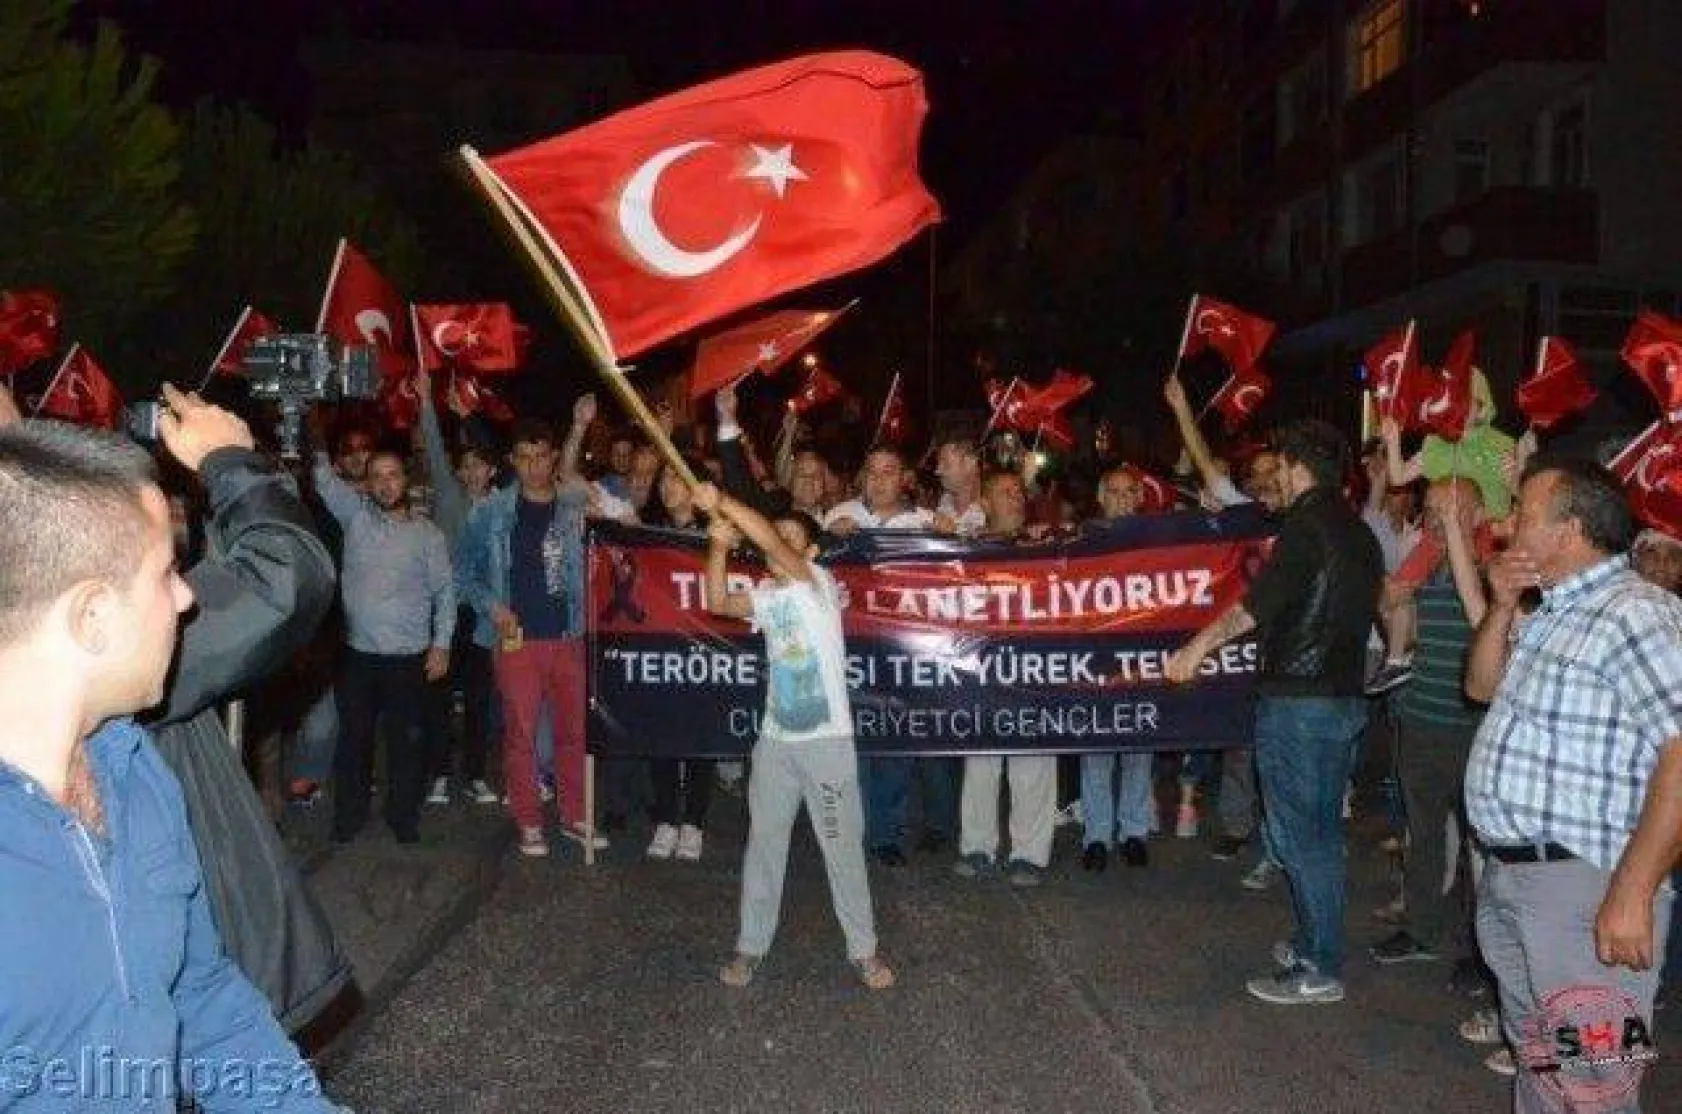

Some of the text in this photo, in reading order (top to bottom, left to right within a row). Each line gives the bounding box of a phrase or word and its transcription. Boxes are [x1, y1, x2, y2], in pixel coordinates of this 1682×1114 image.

[866, 569, 1214, 622] LANETLİYORUZ
[976, 646, 1107, 686] YÜREK,
[993, 702, 1158, 737] GENÇLER
